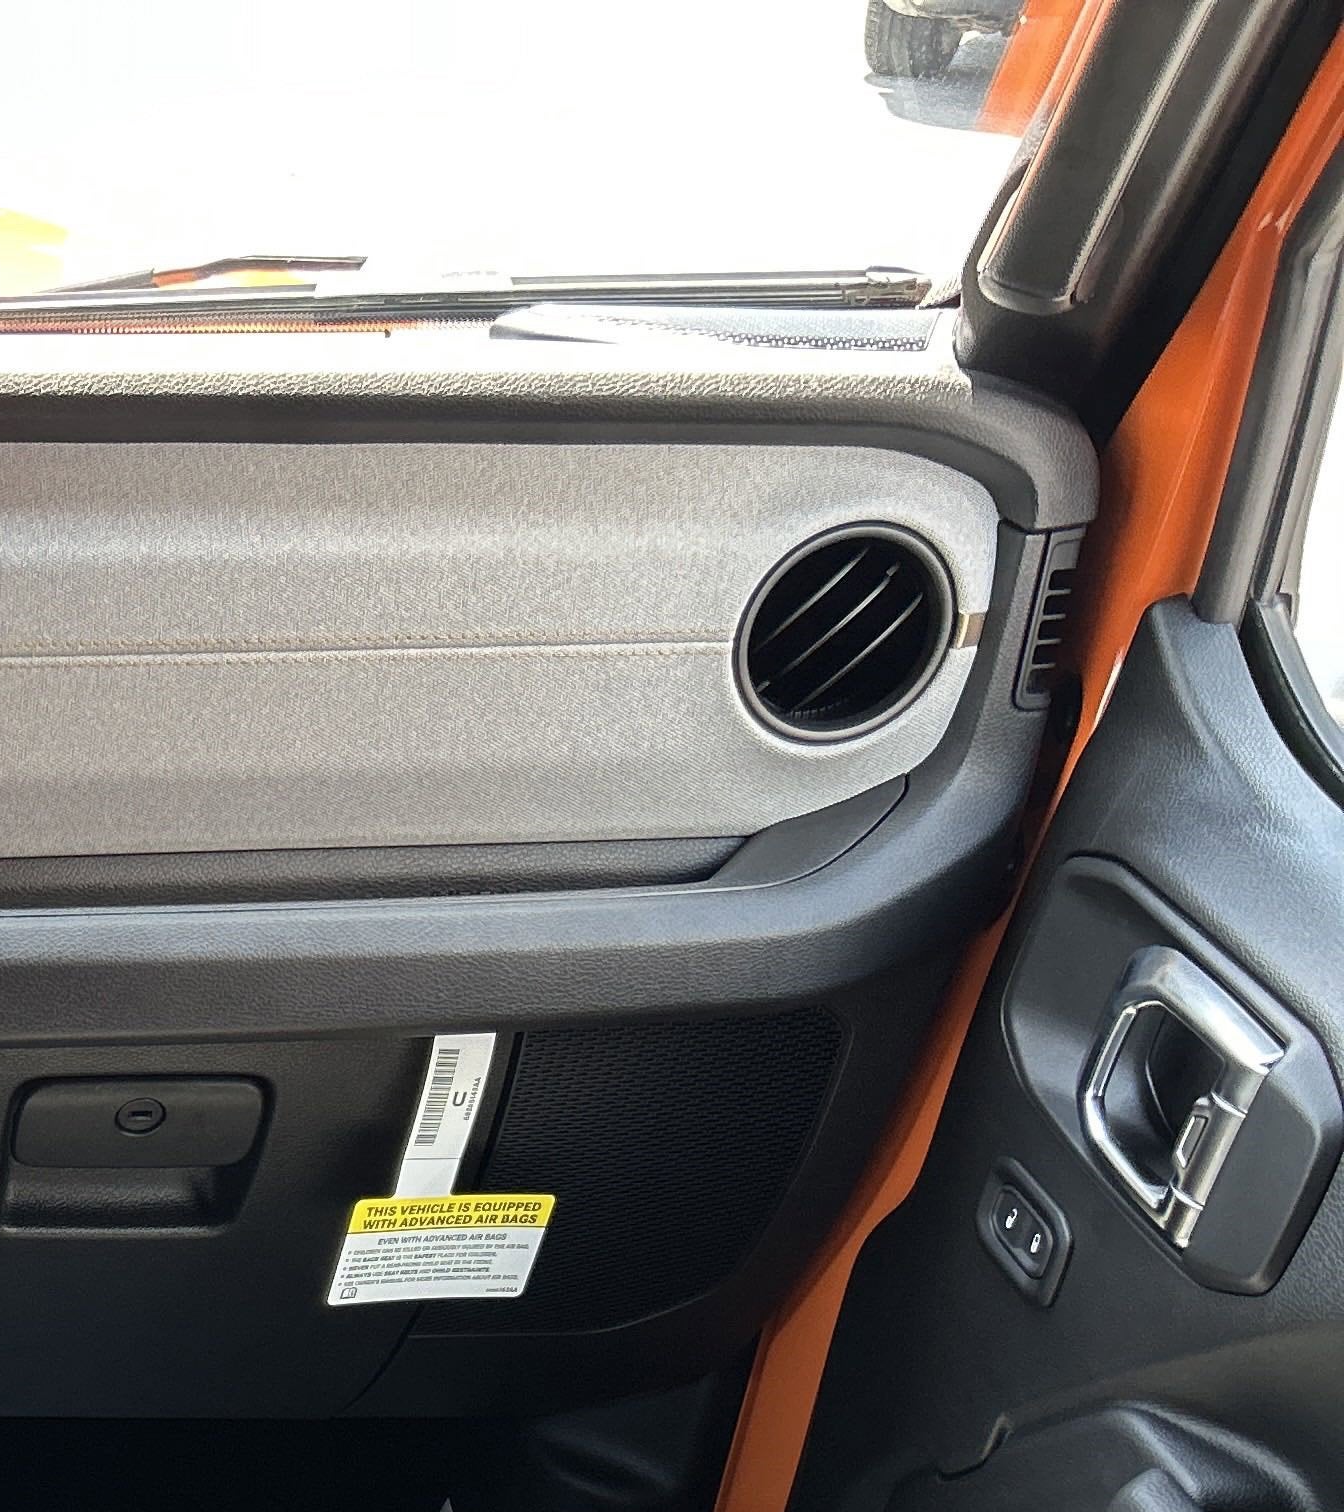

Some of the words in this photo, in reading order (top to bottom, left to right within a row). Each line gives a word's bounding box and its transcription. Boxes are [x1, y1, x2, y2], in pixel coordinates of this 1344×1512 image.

[452, 1091, 468, 1107] U
[366, 1205, 397, 1217] THIS
[401, 1203, 455, 1216] VEHICLE
[458, 1202, 470, 1213] IS
[473, 1201, 542, 1212] EQUIPPED
[363, 1218, 396, 1230] WITH
[399, 1216, 472, 1228] ADVANCED
[474, 1214, 499, 1225] AIR
[502, 1213, 537, 1224] BAGS
[378, 1237, 399, 1246] EVEN
[400, 1236, 422, 1244] WITH
[423, 1234, 468, 1243] ADVANCED
[469, 1233, 484, 1241] AIR
[484, 1232, 507, 1241] BAGS
